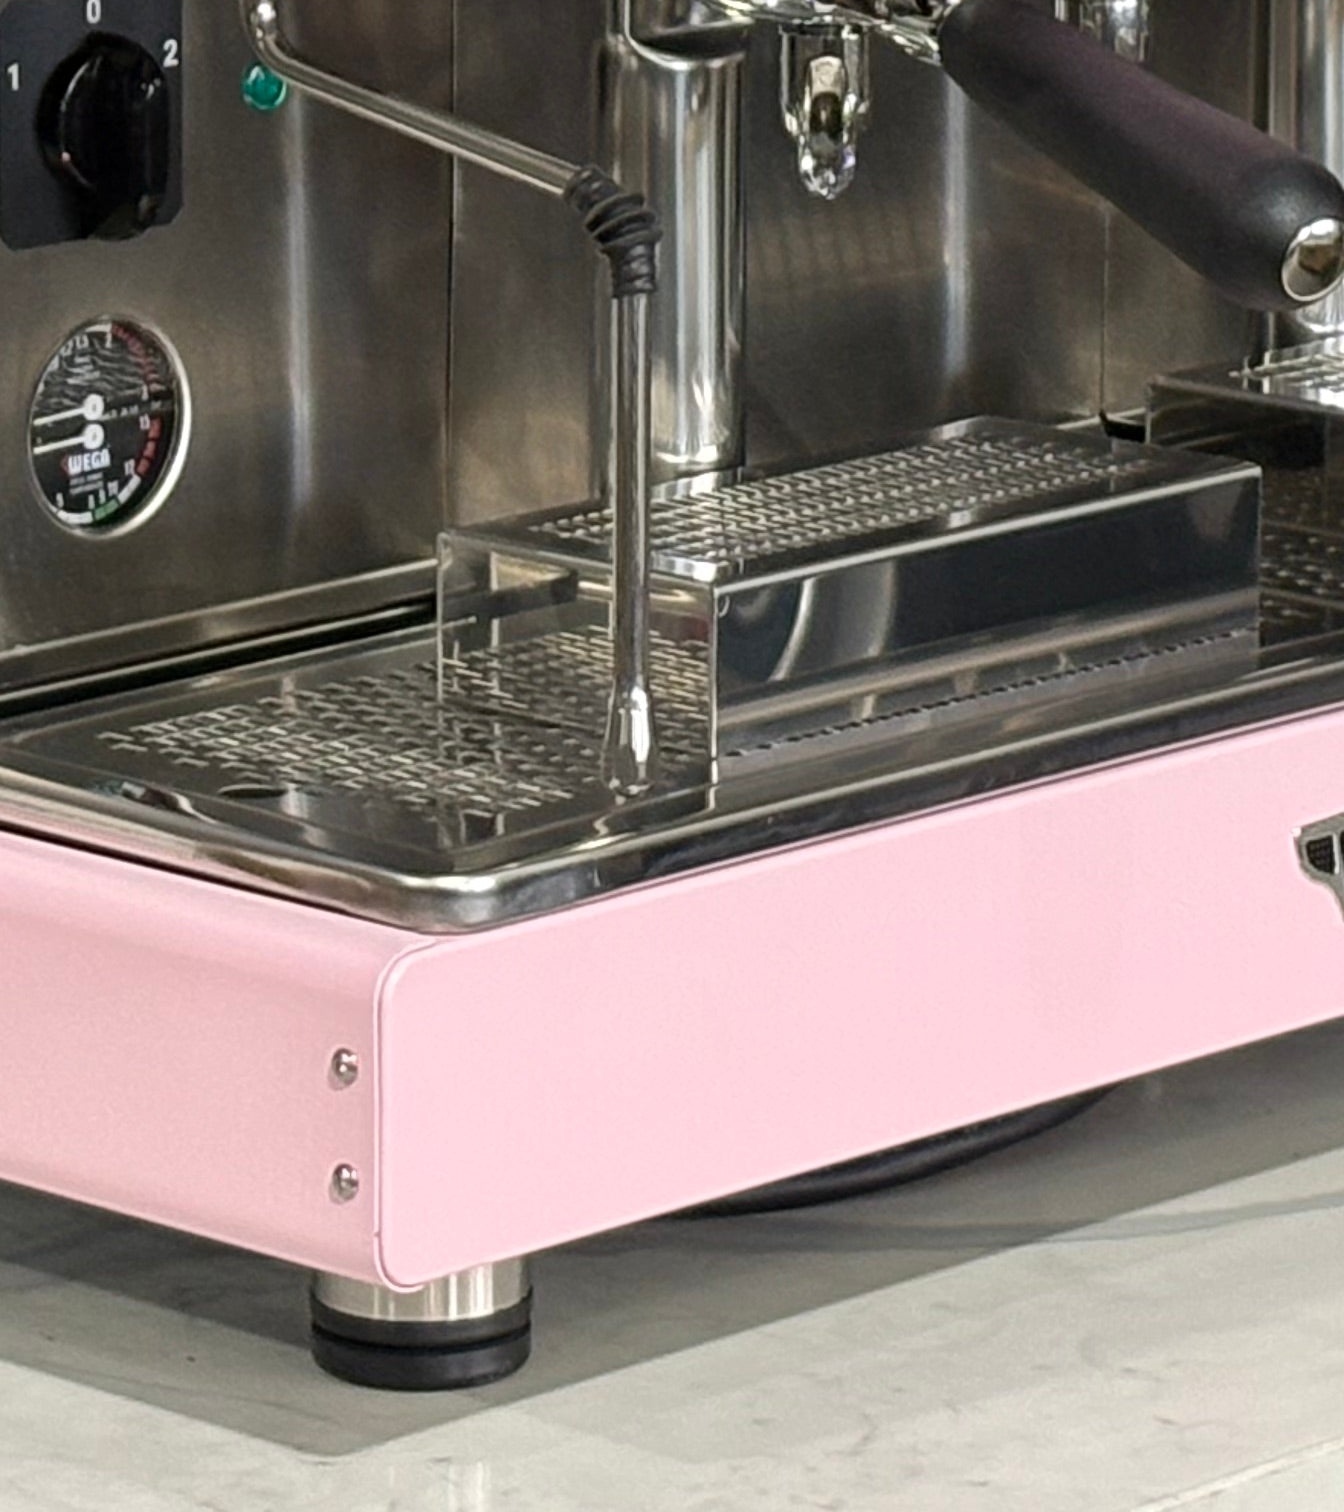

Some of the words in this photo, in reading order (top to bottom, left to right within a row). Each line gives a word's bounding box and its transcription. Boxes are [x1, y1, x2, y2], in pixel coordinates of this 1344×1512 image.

[163, 39, 179, 67] 2
[7, 62, 20, 91] 1
[68, 448, 110, 475] WEGA
